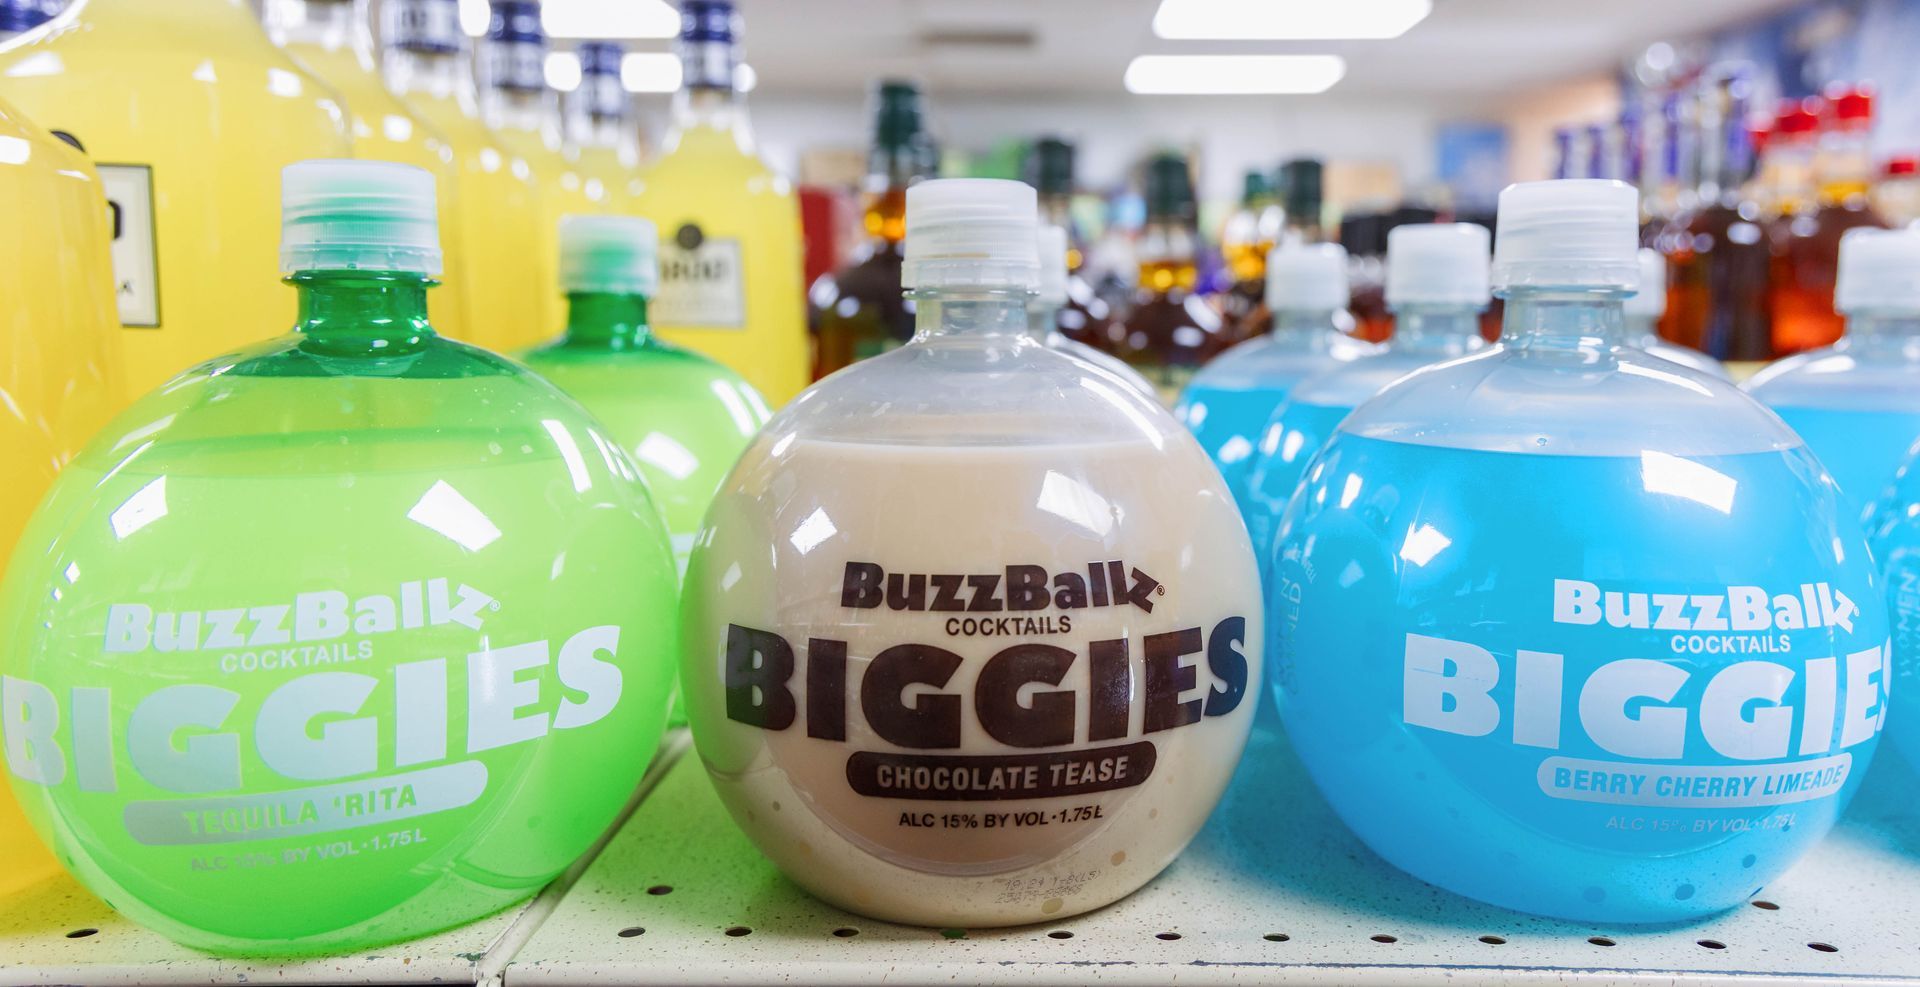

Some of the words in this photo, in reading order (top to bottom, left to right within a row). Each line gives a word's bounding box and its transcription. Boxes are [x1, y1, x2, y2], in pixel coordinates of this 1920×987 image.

[945, 615, 1072, 637] COCKTAILS
[220, 640, 374, 675] COCKTAILS
[1671, 634, 1792, 654] COCKTAILS
[726, 616, 1248, 749] BIGGIES
[2, 624, 624, 794] BIGGIES
[877, 764, 1038, 791] CHOCOLATE
[1049, 756, 1129, 787] TEASE
[1553, 767, 1647, 795] BERRY
[1656, 770, 1758, 798] CHERRY
[1763, 764, 1845, 796] LIMEADE
[184, 799, 319, 834] TEQUILA
[334, 784, 417, 816] 'RITA
[898, 811, 935, 827] ALC
[941, 812, 978, 829] 15%
[983, 811, 1010, 829] BY
[1606, 815, 1644, 832] ALC
[1692, 816, 1720, 832] BY
[281, 848, 310, 864] BY
